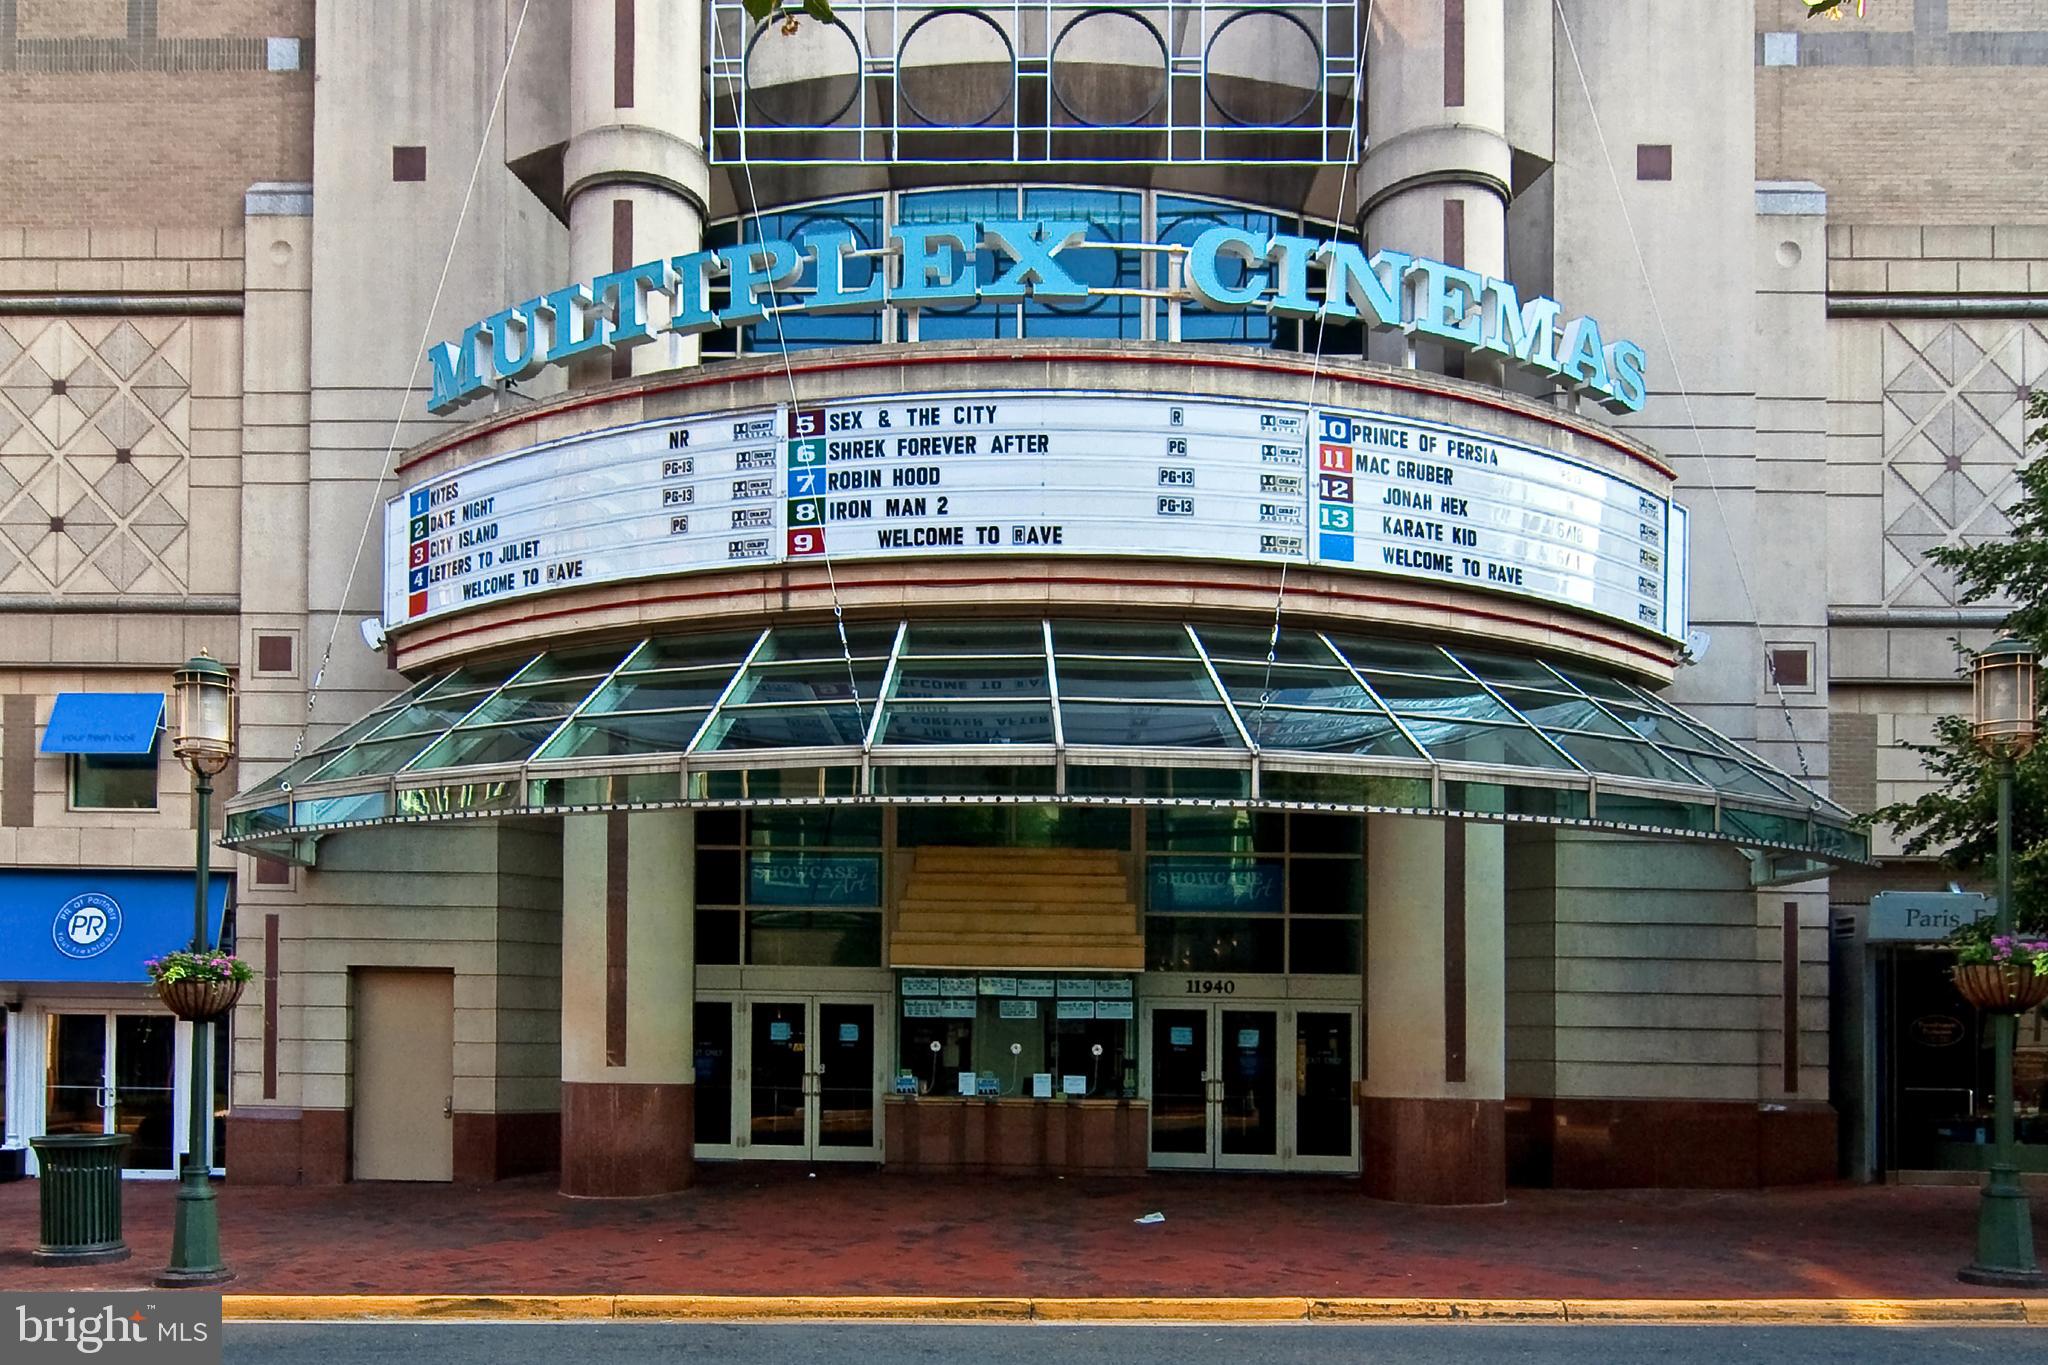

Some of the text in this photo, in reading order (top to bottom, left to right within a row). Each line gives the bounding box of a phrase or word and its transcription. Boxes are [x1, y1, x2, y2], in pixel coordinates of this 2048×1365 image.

[427, 220, 1646, 415] MULTIPLEX CINEMAS
[796, 415, 815, 434] 5
[829, 405, 997, 431] SEX & THE CITY
[1319, 419, 1346, 439] 10
[669, 430, 689, 449] NR
[829, 434, 1049, 461] SHREK FOREVER AFTER
[1169, 440, 1185, 454] PG
[1351, 424, 1498, 467] PRINCE OF PERSIA
[797, 444, 816, 463] 6
[1322, 449, 1344, 469] 11
[664, 461, 693, 476] PG-13
[828, 466, 940, 491] ROBIN HOOD
[1160, 471, 1193, 484] PG-13
[1355, 453, 1454, 486] MAC GRUBER
[796, 475, 815, 493] 7
[1321, 478, 1349, 499] 12
[430, 483, 459, 507] KITES
[664, 489, 693, 504] PG-13
[1382, 487, 1468, 517] JONAH HEX
[416, 500, 424, 512] 1
[430, 497, 495, 532] DATE NIGHT
[796, 503, 815, 521] 8
[829, 496, 948, 520] IRON MAN 2
[1159, 499, 1192, 513] PG-13
[673, 518, 687, 533] PG
[1320, 507, 1349, 528] 13
[414, 521, 424, 536] 2
[878, 525, 1062, 548] WELCOME TO RAVE
[1383, 515, 1477, 547] KARATE KID
[430, 523, 498, 558] CITY ISLAND
[793, 534, 813, 552] 9
[414, 548, 424, 563] 3
[429, 540, 540, 583] LETTERS TO JULIET
[1383, 546, 1523, 585] WELCOME TO RAVE
[413, 571, 424, 586] 4
[463, 560, 583, 600] WELCOME TO RAVE
[70, 915, 104, 936] PR
[1904, 908, 1960, 928] Paris
[1185, 979, 1235, 994] 11940
